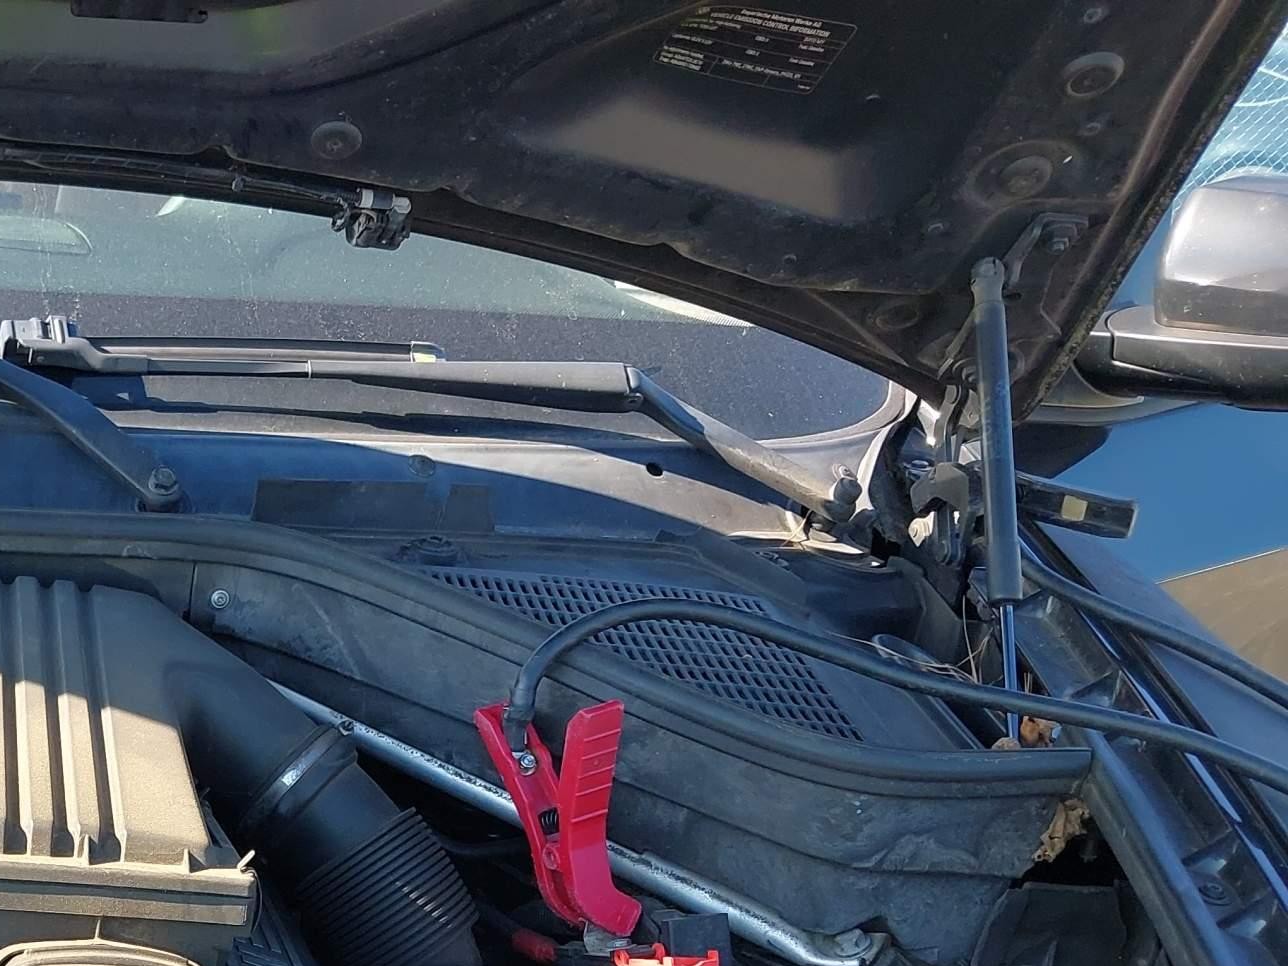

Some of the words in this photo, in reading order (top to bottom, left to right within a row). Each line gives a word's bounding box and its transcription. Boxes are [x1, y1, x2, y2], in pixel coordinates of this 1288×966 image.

[710, 12, 733, 20] VEHICLE
[733, 14, 762, 25] EMISSION
[762, 19, 789, 31] CONTROL
[789, 25, 832, 38] INFORMATION
